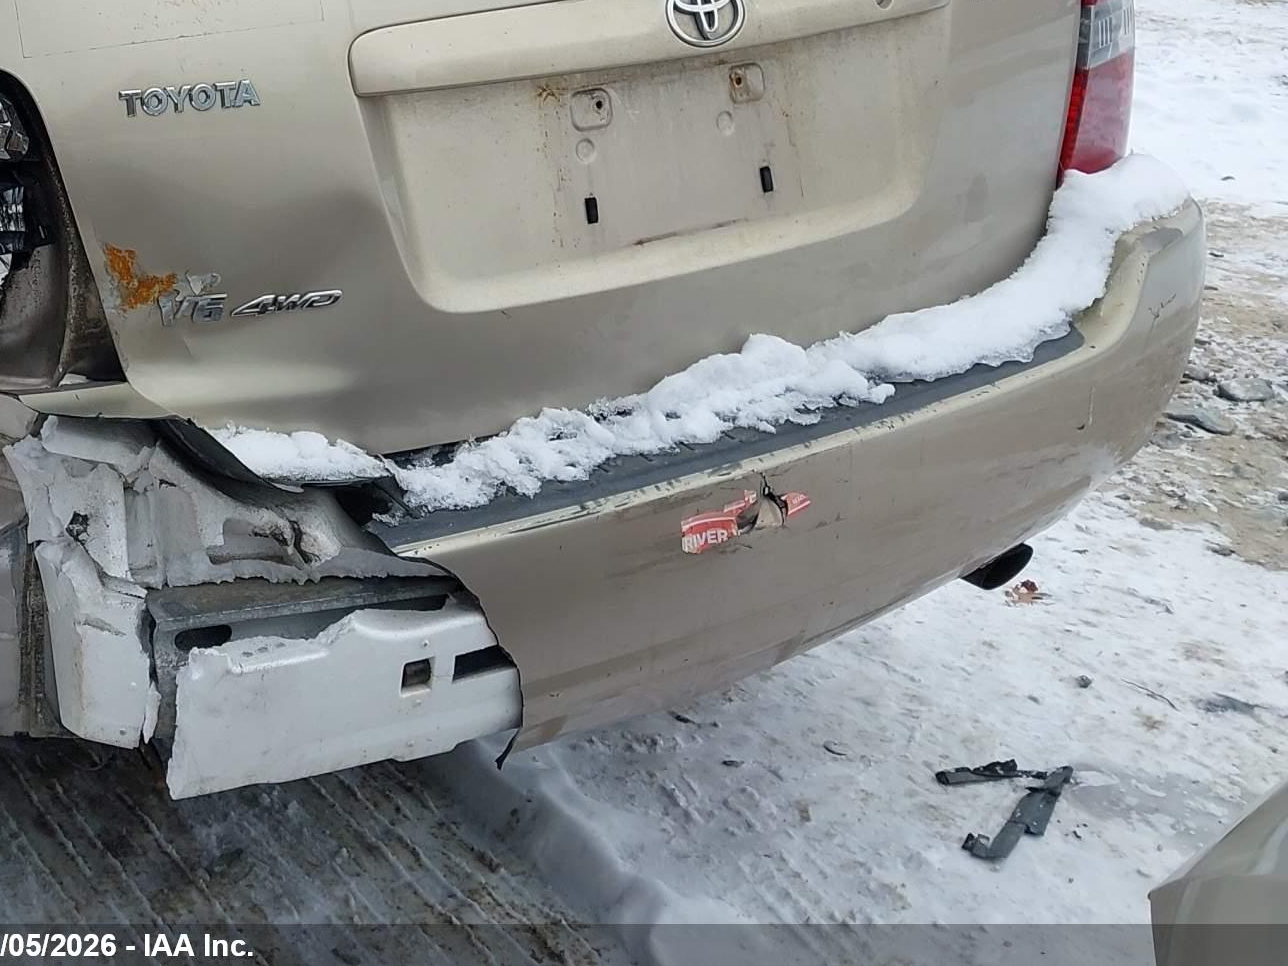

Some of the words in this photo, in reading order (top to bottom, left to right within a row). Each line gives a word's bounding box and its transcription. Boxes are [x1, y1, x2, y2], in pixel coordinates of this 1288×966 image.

[118, 78, 261, 117] TOYOTA
[158, 293, 228, 326] V6
[231, 289, 344, 318] 4WD
